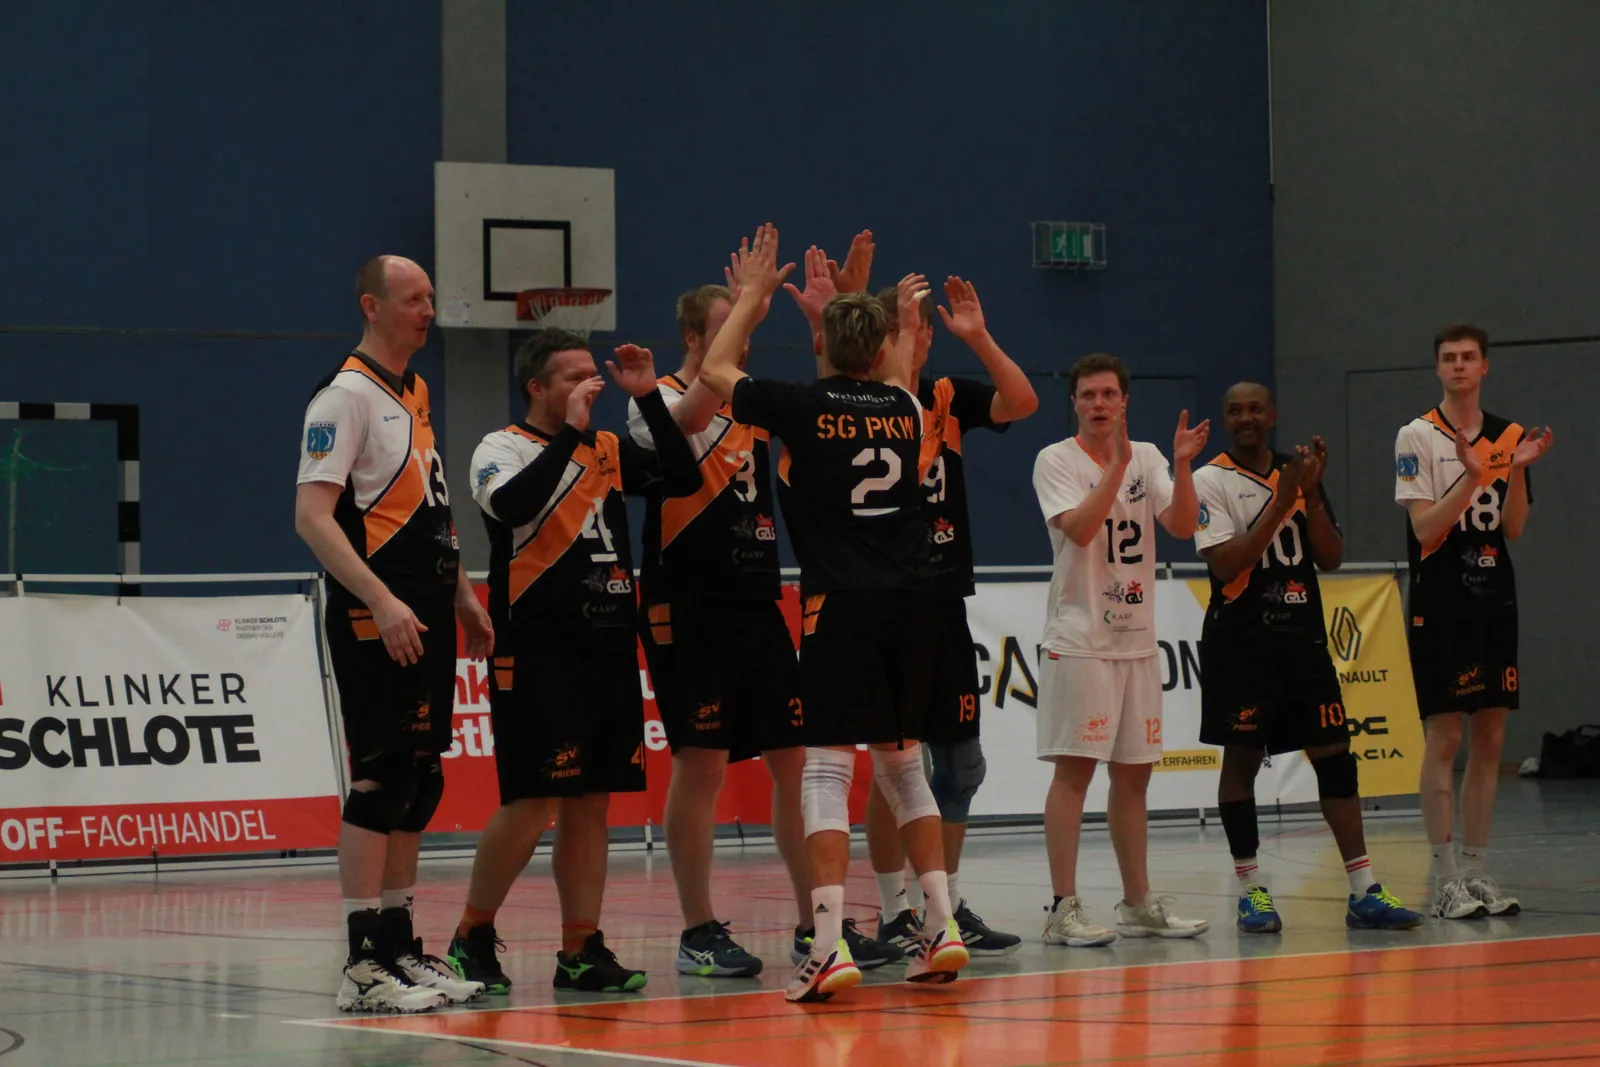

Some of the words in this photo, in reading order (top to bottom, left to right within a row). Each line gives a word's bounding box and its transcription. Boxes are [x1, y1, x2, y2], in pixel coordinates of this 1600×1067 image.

[817, 413, 857, 439] SG
[864, 415, 915, 440] PKW
[412, 448, 450, 508] 13
[851, 448, 902, 517] 2
[581, 497, 619, 563] 4
[1105, 518, 1143, 564] 12
[607, 578, 632, 594] GAS
[46, 672, 247, 707] KLINKER
[1339, 669, 1388, 684] NAULT
[959, 692, 976, 722] 19
[1319, 703, 1344, 729] 10
[0, 714, 261, 770] SCHLOTE
[1145, 717, 1161, 744] 12
[1163, 755, 1217, 767] ERFAHREN
